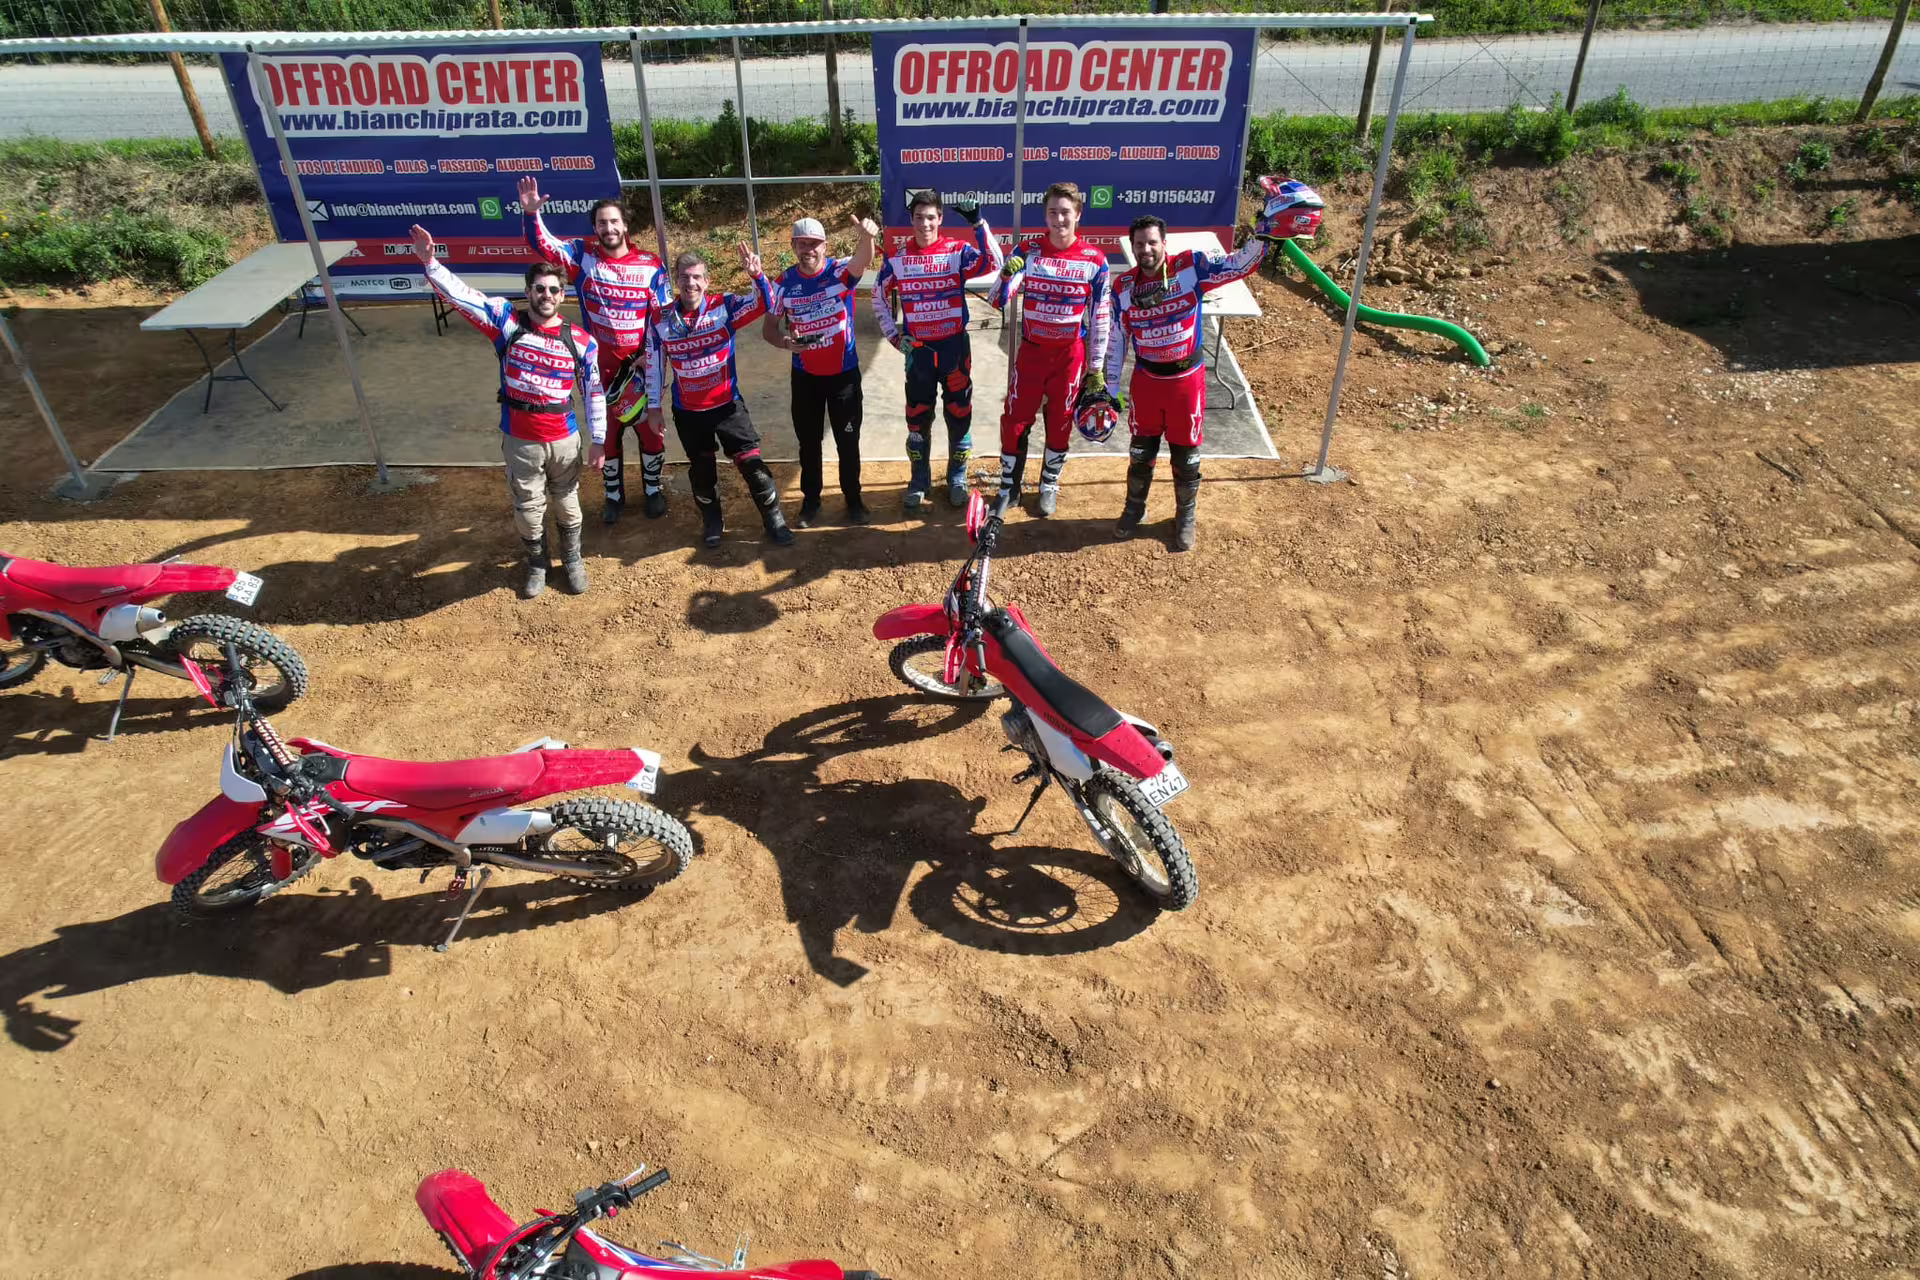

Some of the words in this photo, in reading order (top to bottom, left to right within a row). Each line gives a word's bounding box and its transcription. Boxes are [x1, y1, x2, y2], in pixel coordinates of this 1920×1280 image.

[900, 49, 1072, 95] OFFROAD
[1080, 48, 1226, 91] CENTER
[436, 60, 580, 104] CENTER
[903, 96, 1219, 119] www.bianchiprata.com
[901, 148, 941, 163] MOTOS
[942, 148, 958, 162] DE
[959, 147, 1004, 162] ENDURO
[1023, 147, 1049, 161] ULAS
[1060, 146, 1111, 161] PASSEIOS
[1119, 146, 1166, 160] ALUGUER
[1176, 146, 1220, 160] PROVAS
[322, 160, 338, 174] DE
[338, 159, 384, 174] ENDURO
[394, 159, 428, 174] AULAS
[438, 159, 488, 172] PASSEIOS
[496, 158, 543, 171] ALUGUER
[551, 156, 595, 170] PROVAS
[1117, 190, 1147, 204] +351
[1149, 190, 1215, 204] 911564347
[331, 202, 476, 216] info@bianchiprata.com
[478, 246, 533, 255] JOCEL
[590, 283, 647, 299] HONDA
[901, 278, 957, 292] HONDA
[1026, 280, 1086, 295] HONDA
[600, 306, 638, 319] MOTUL
[913, 300, 951, 312] MOTUL
[1036, 302, 1074, 315] MOTUL
[1129, 299, 1190, 318] HONDA
[796, 316, 840, 331] HONDA
[1141, 322, 1184, 339] MOTUL
[667, 334, 723, 352] HONDA
[511, 347, 575, 370] HONDA
[682, 354, 718, 370] MOTUL
[520, 371, 563, 389] MOTUL
[1149, 785, 1170, 804] EN
